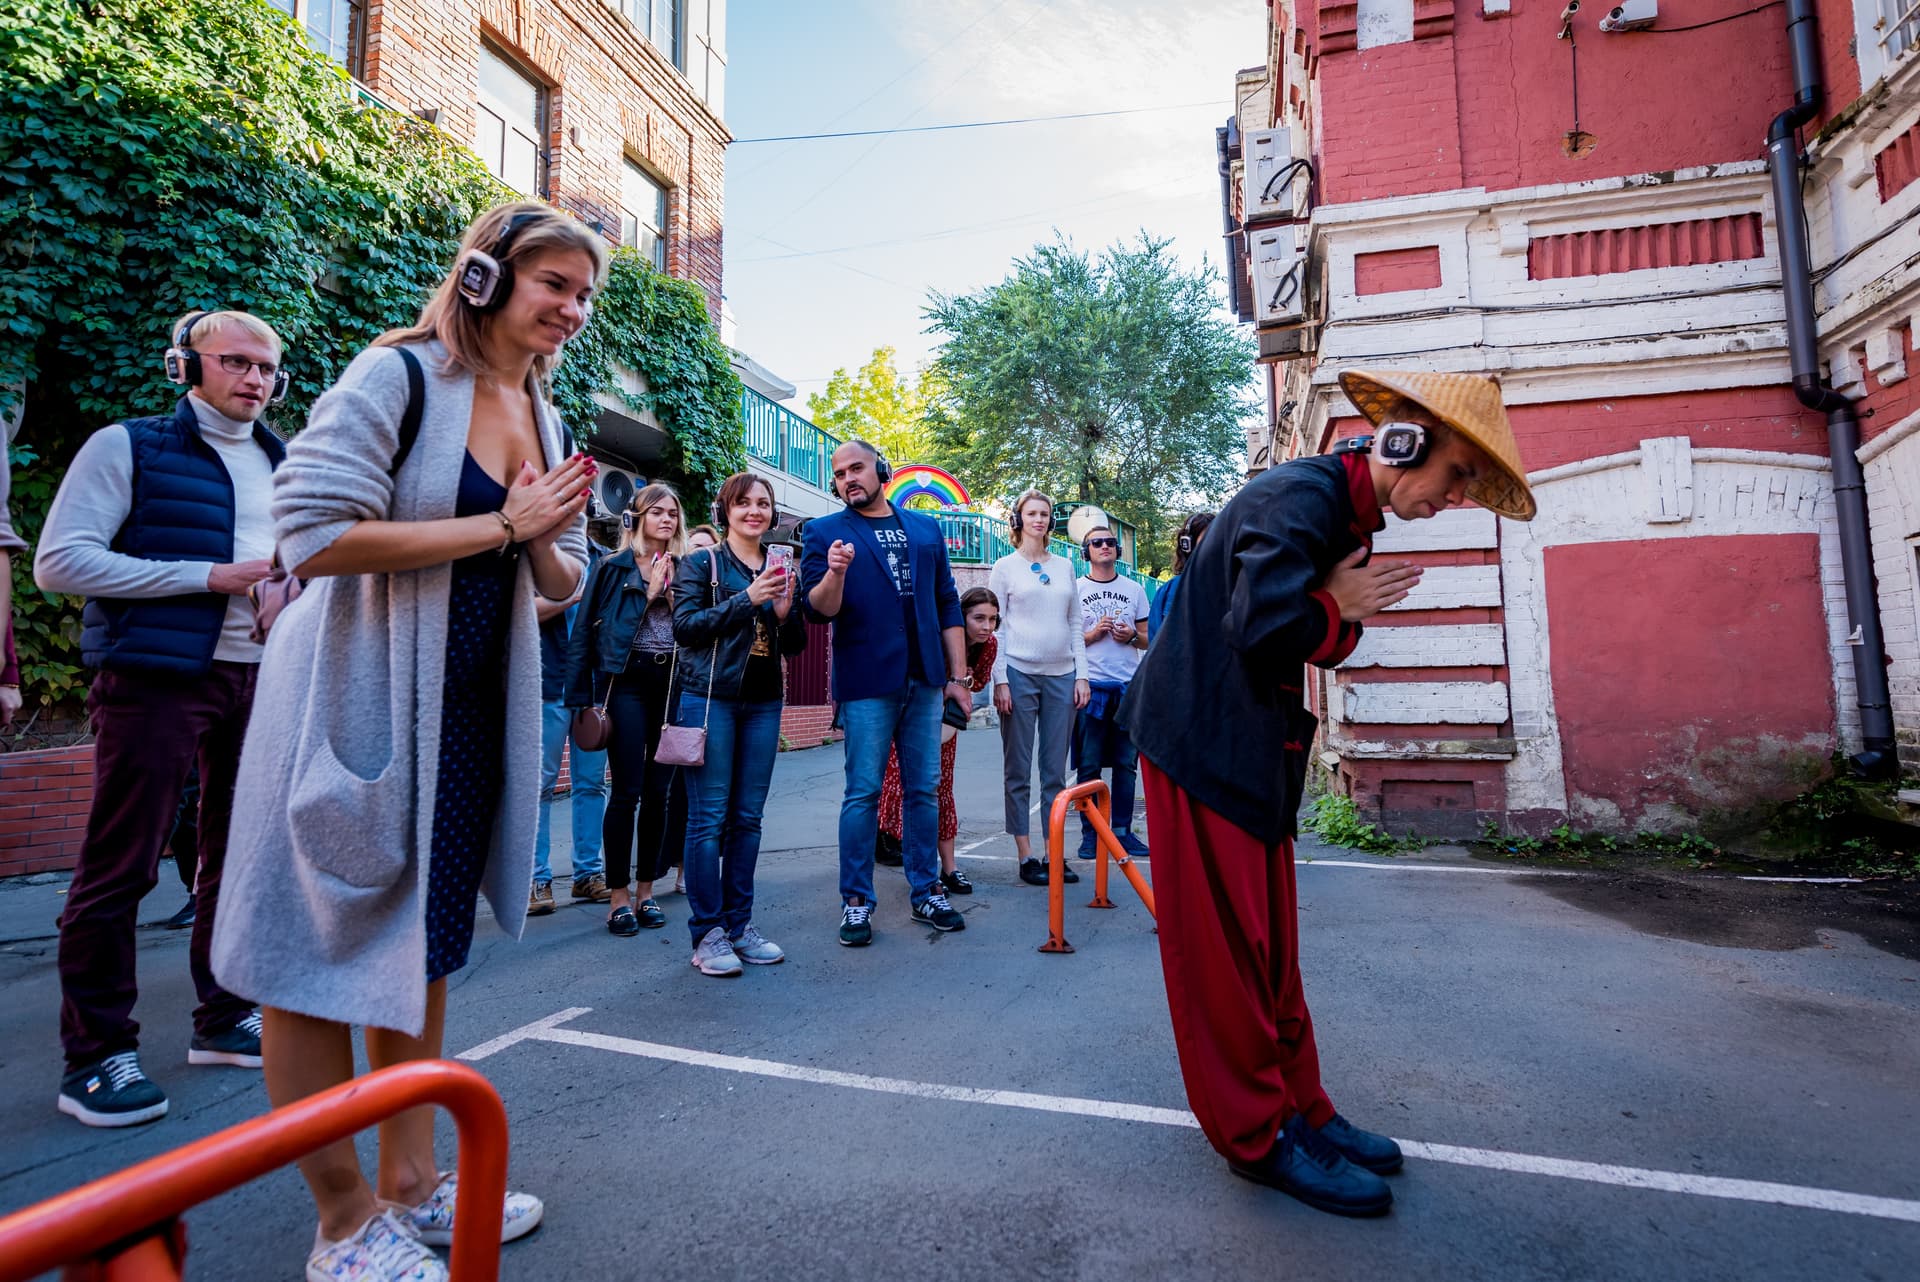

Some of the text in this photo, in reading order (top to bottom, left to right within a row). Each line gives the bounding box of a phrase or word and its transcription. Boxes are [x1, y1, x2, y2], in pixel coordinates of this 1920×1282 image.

[874, 529, 907, 542] ERS
[1083, 591, 1129, 605] PAUL FRANK
[922, 904, 935, 918] N
